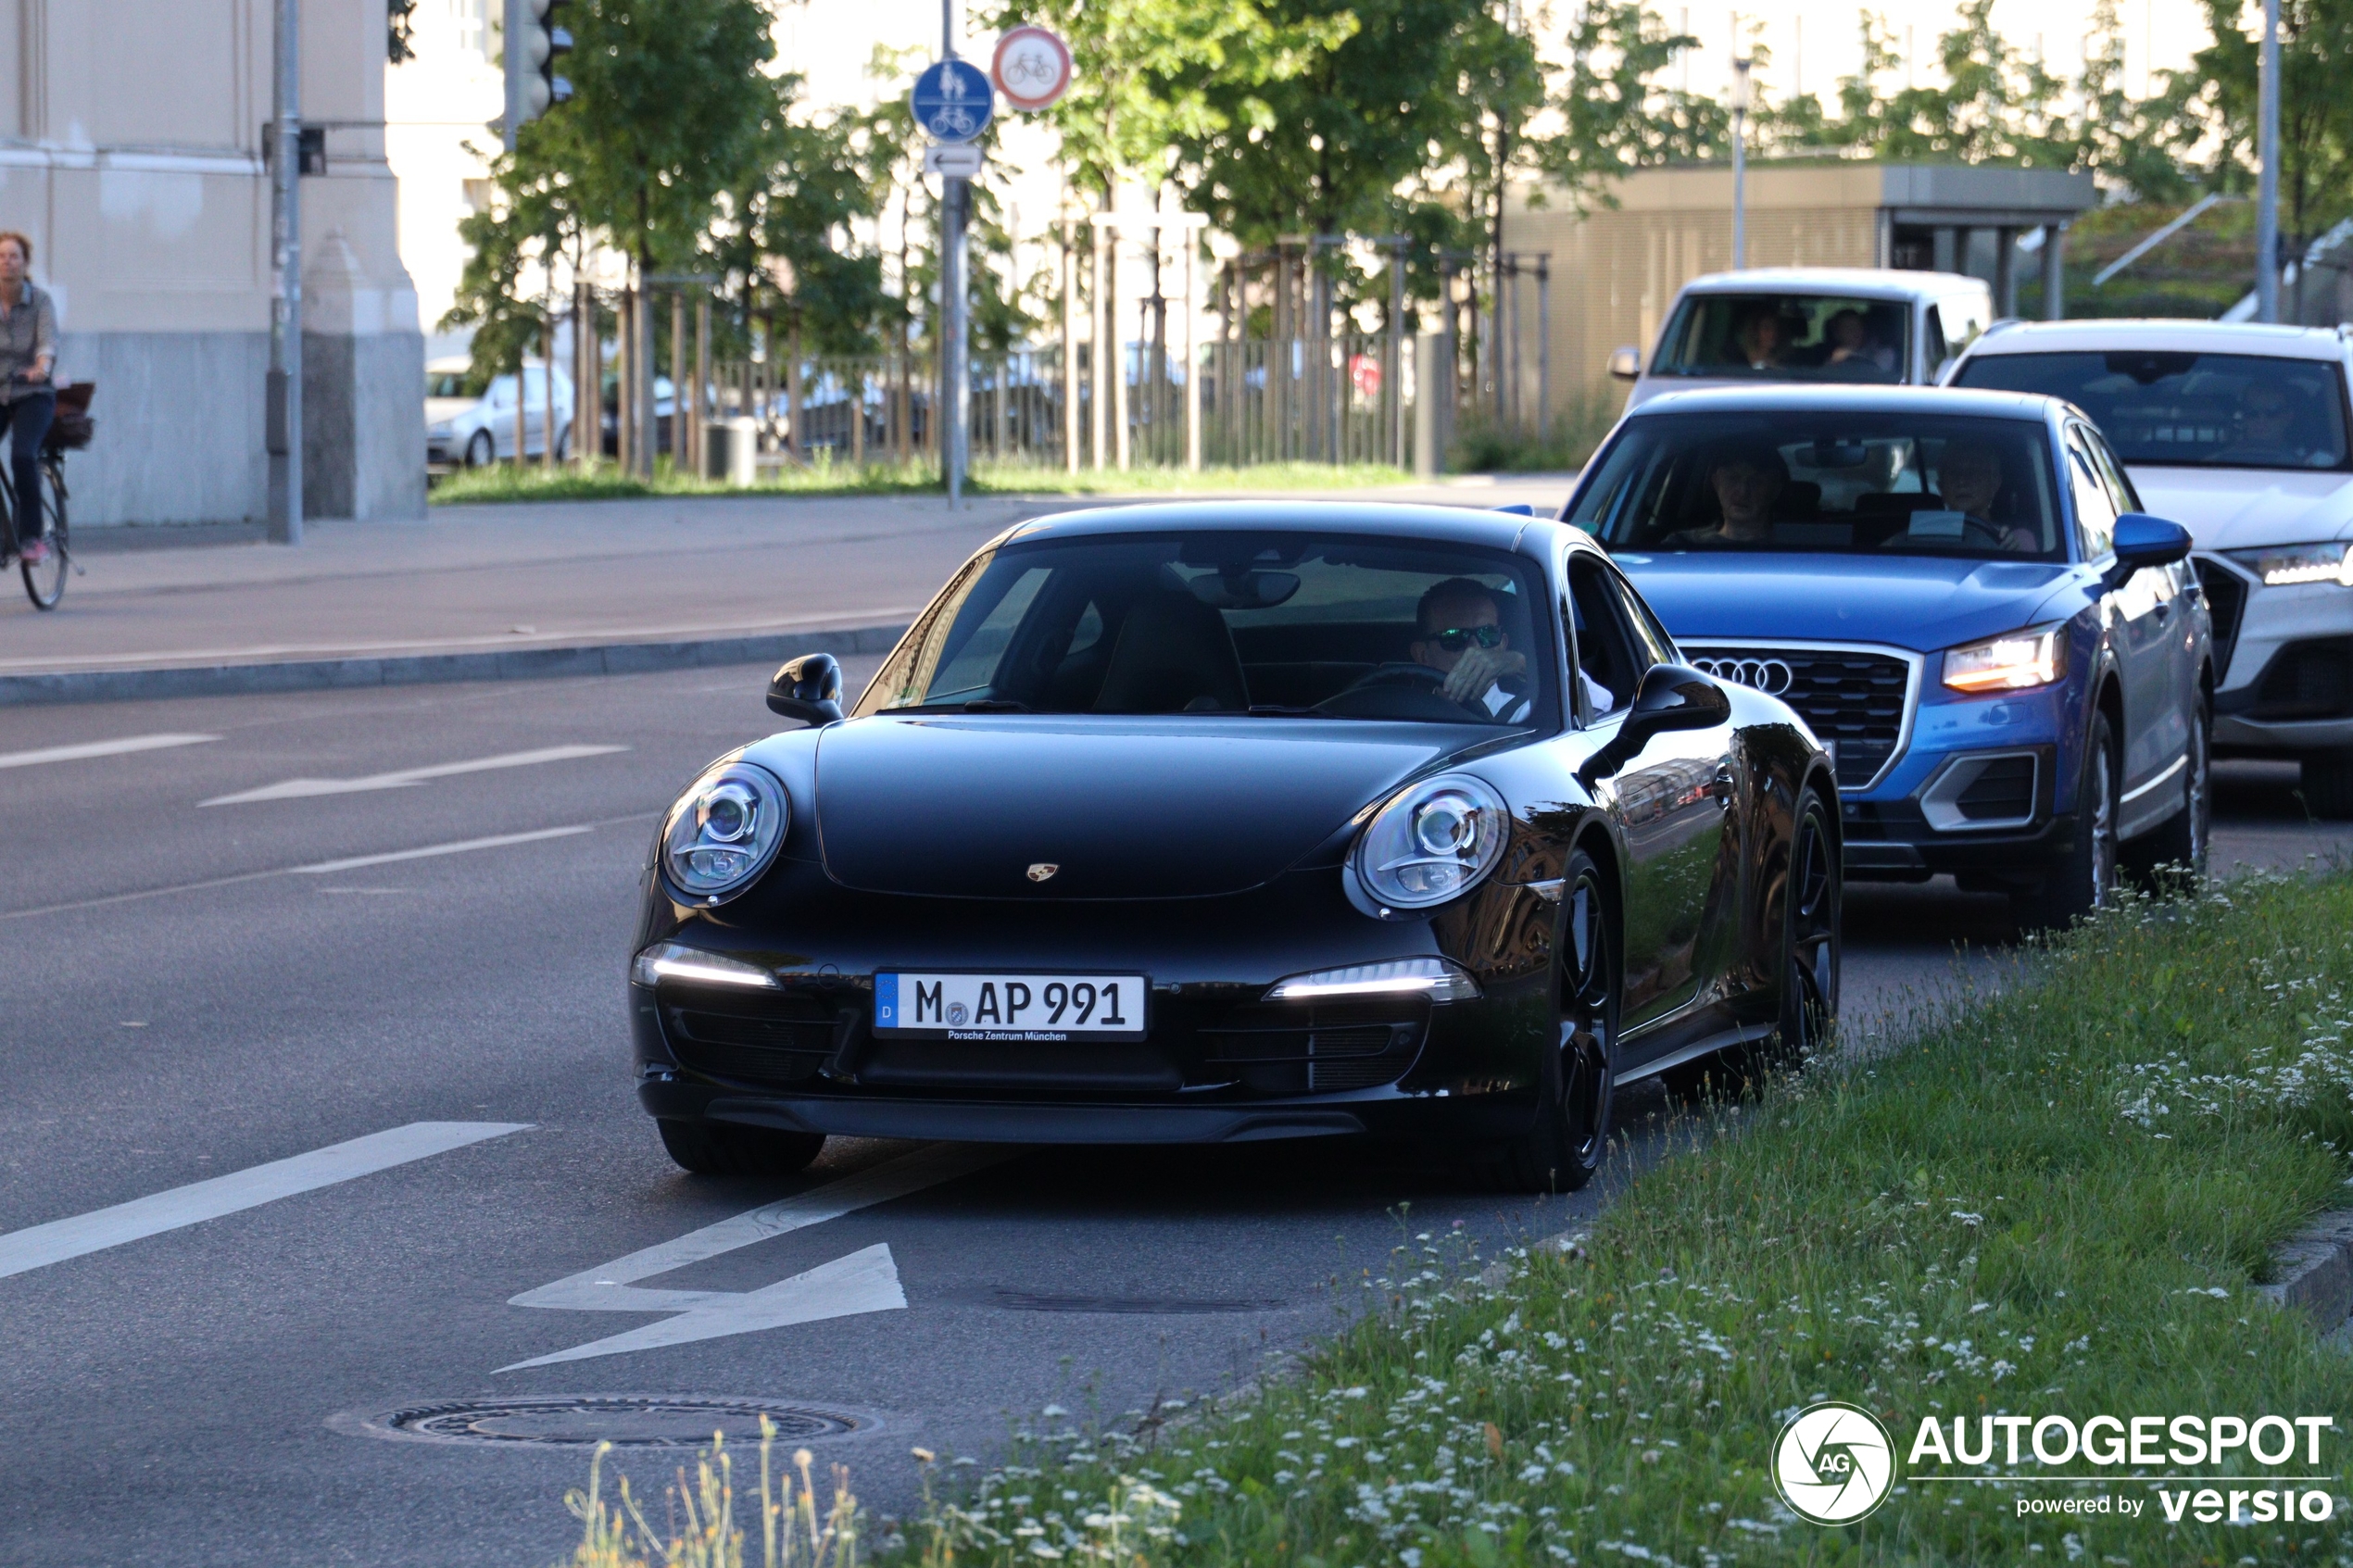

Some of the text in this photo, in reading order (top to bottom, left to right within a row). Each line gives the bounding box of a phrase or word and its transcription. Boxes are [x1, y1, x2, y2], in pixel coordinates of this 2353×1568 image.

[915, 980, 1126, 1025] M AP 991
[882, 1006, 892, 1018] D
[948, 1030, 1066, 1041] Porsche Zentrum München
